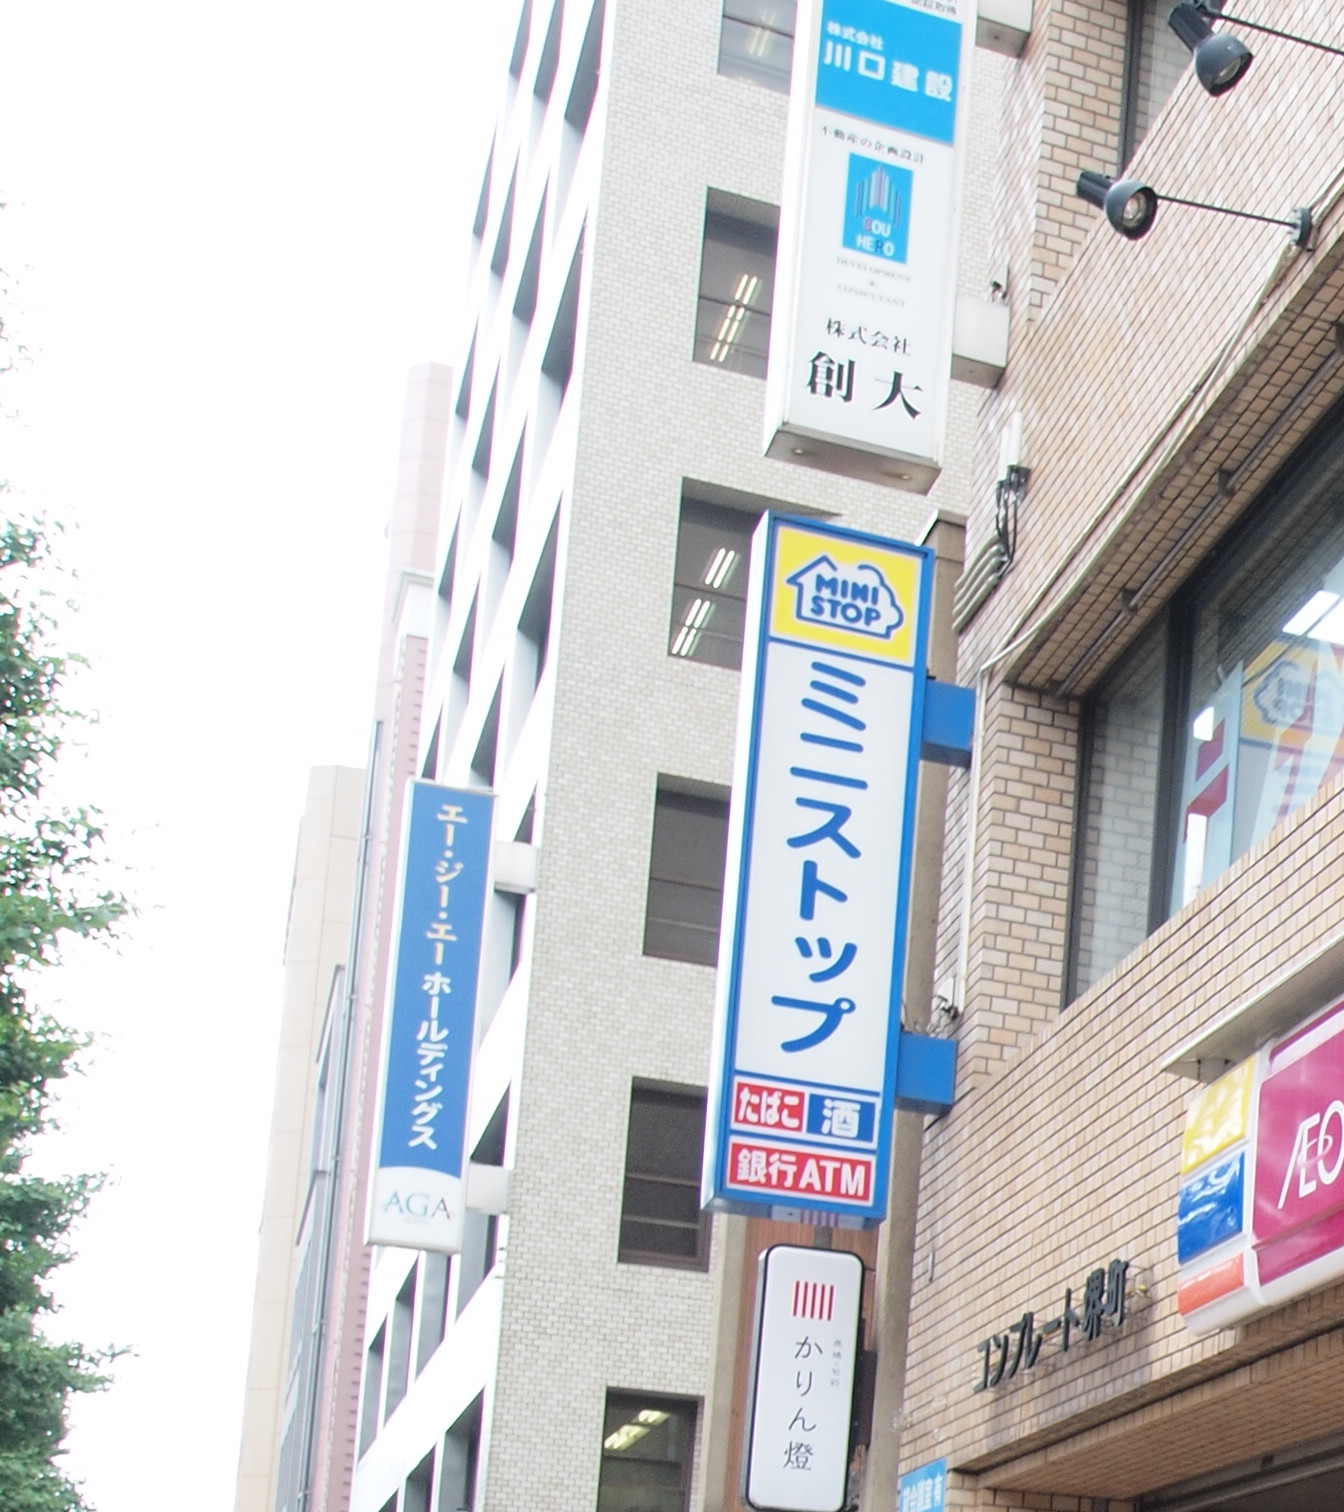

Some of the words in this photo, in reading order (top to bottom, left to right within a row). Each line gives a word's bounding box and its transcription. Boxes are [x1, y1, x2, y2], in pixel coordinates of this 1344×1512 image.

[827, 20, 884, 51] 株式会社
[823, 39, 953, 103] 川口建設
[856, 234, 895, 257] HERO
[826, 317, 911, 356] 株式会社
[807, 350, 923, 420] 創大
[811, 593, 882, 629] STOP
[815, 571, 880, 606] MINI
[771, 660, 868, 1053] ミニストップ
[737, 1087, 801, 1131] たばこ
[820, 1099, 861, 1139] 酒
[737, 1149, 868, 1200] 銀行ATM
[383, 1193, 452, 1222] AGA
[783, 1336, 823, 1471] かりん燈
